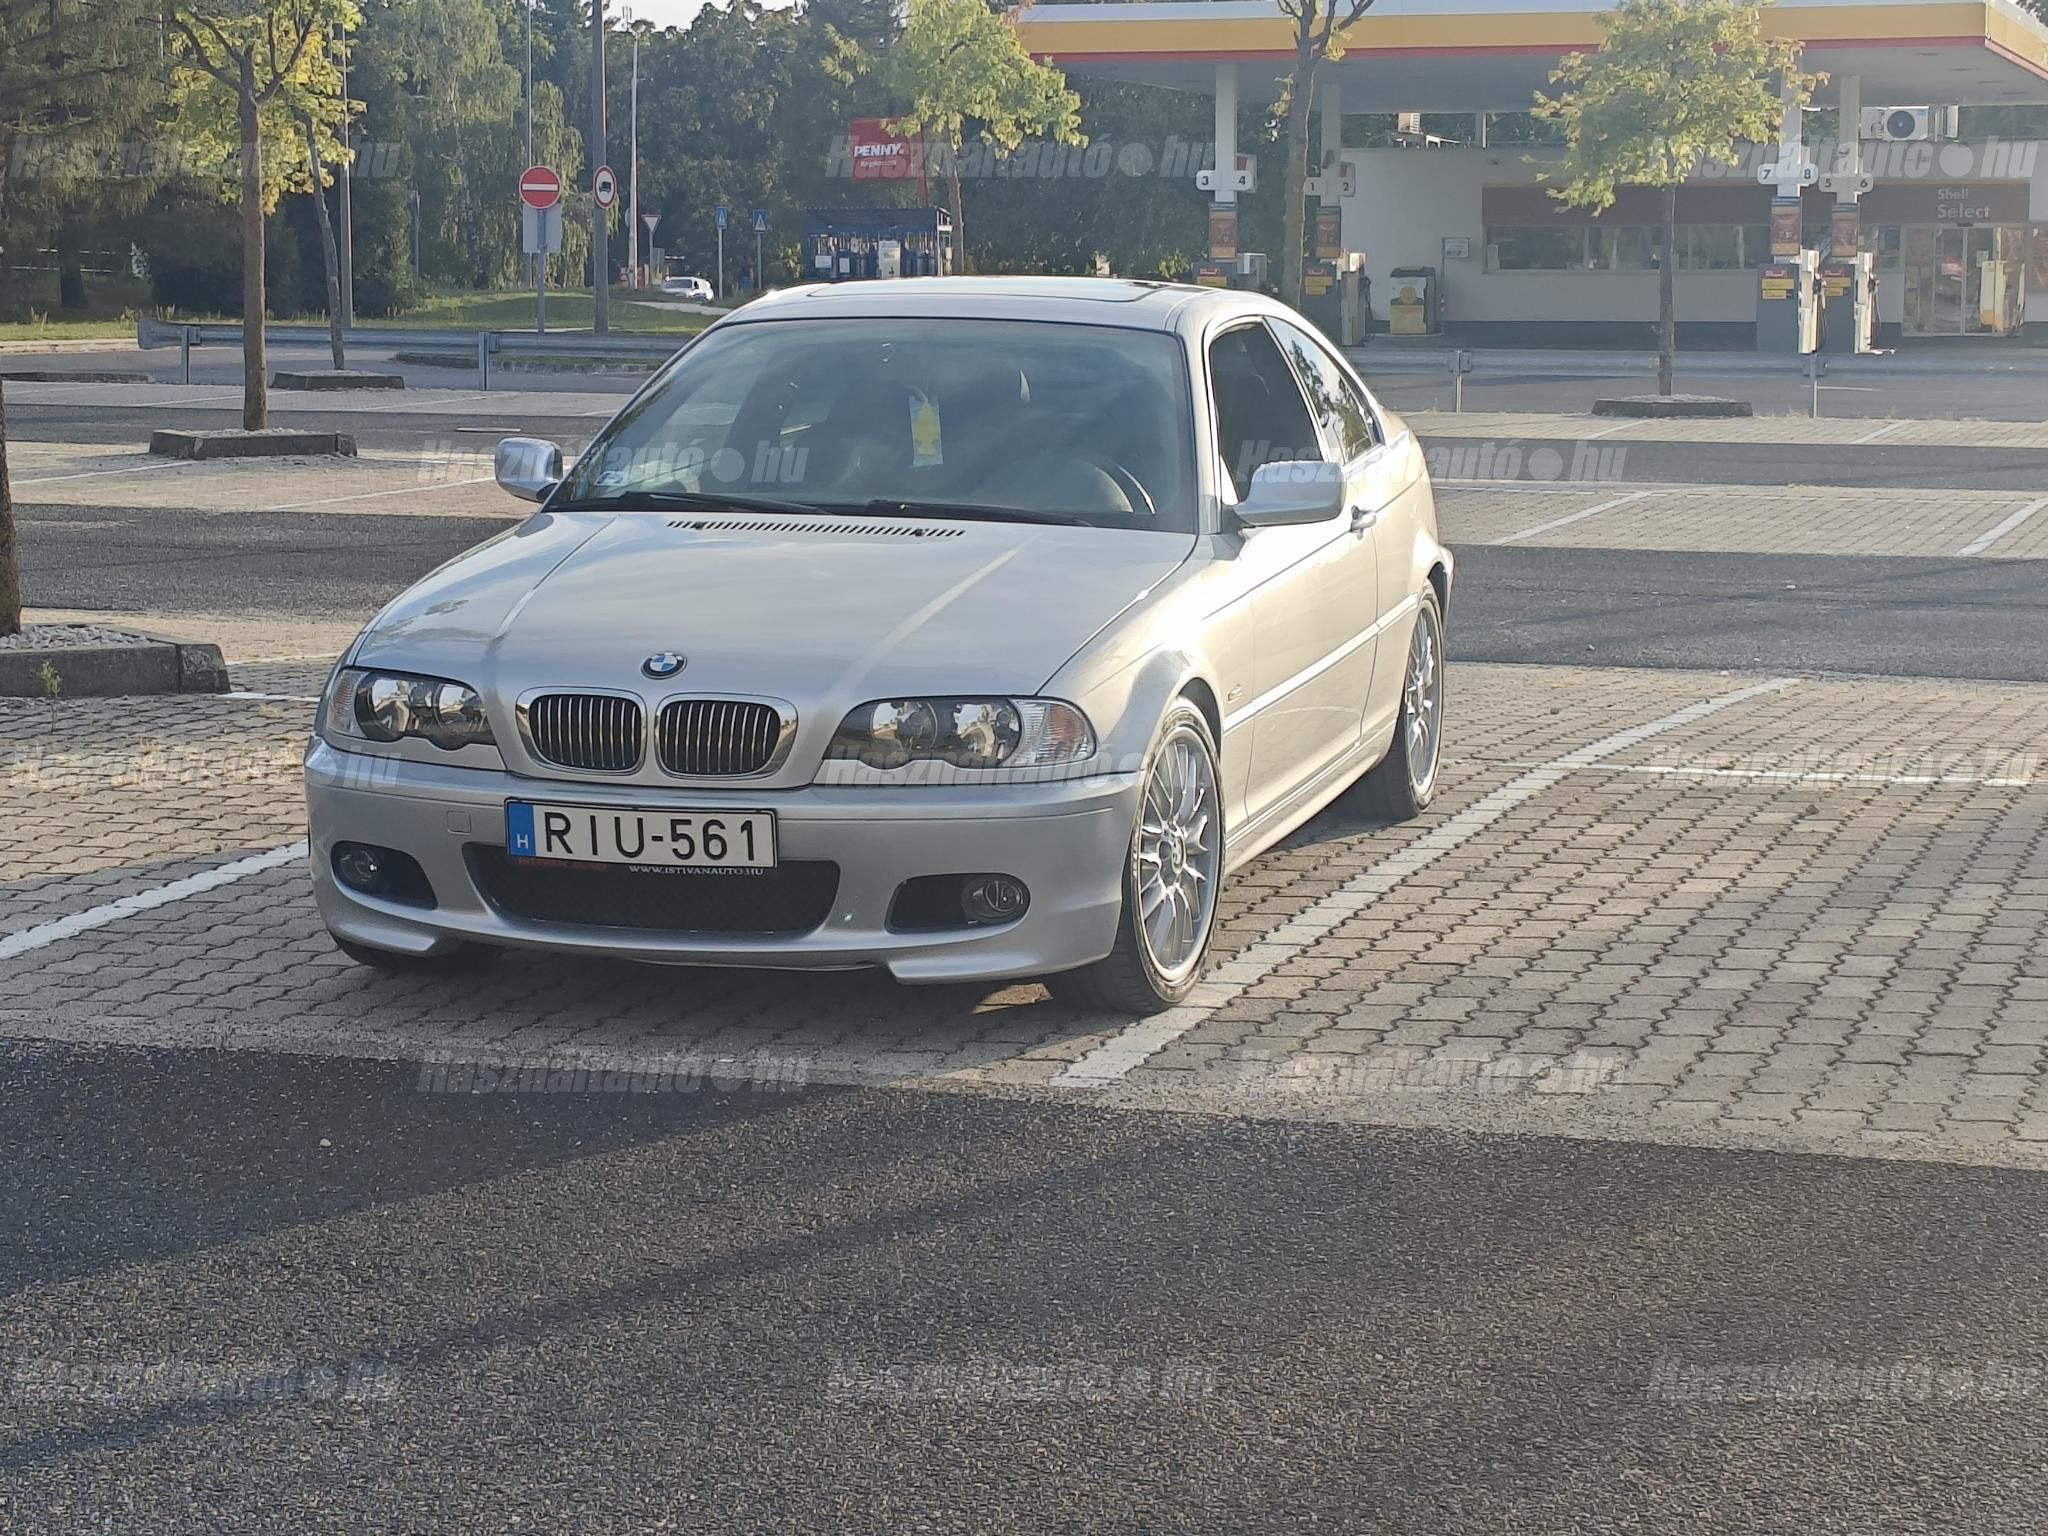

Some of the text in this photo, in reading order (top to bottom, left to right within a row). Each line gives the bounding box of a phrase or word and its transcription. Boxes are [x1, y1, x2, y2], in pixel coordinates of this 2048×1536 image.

[1763, 169, 1771, 179] 7
[1804, 169, 1811, 179] 8
[1201, 176, 1209, 186] 3
[1238, 176, 1246, 185] 4
[1824, 178, 1831, 188] 5
[1860, 178, 1868, 188] 6
[1310, 182, 1315, 191] 1
[1343, 182, 1349, 191] 2
[1937, 188, 1969, 200] Shell
[1937, 203, 1990, 218] Select
[517, 833, 529, 849] H
[544, 811, 755, 861] RIU-561
